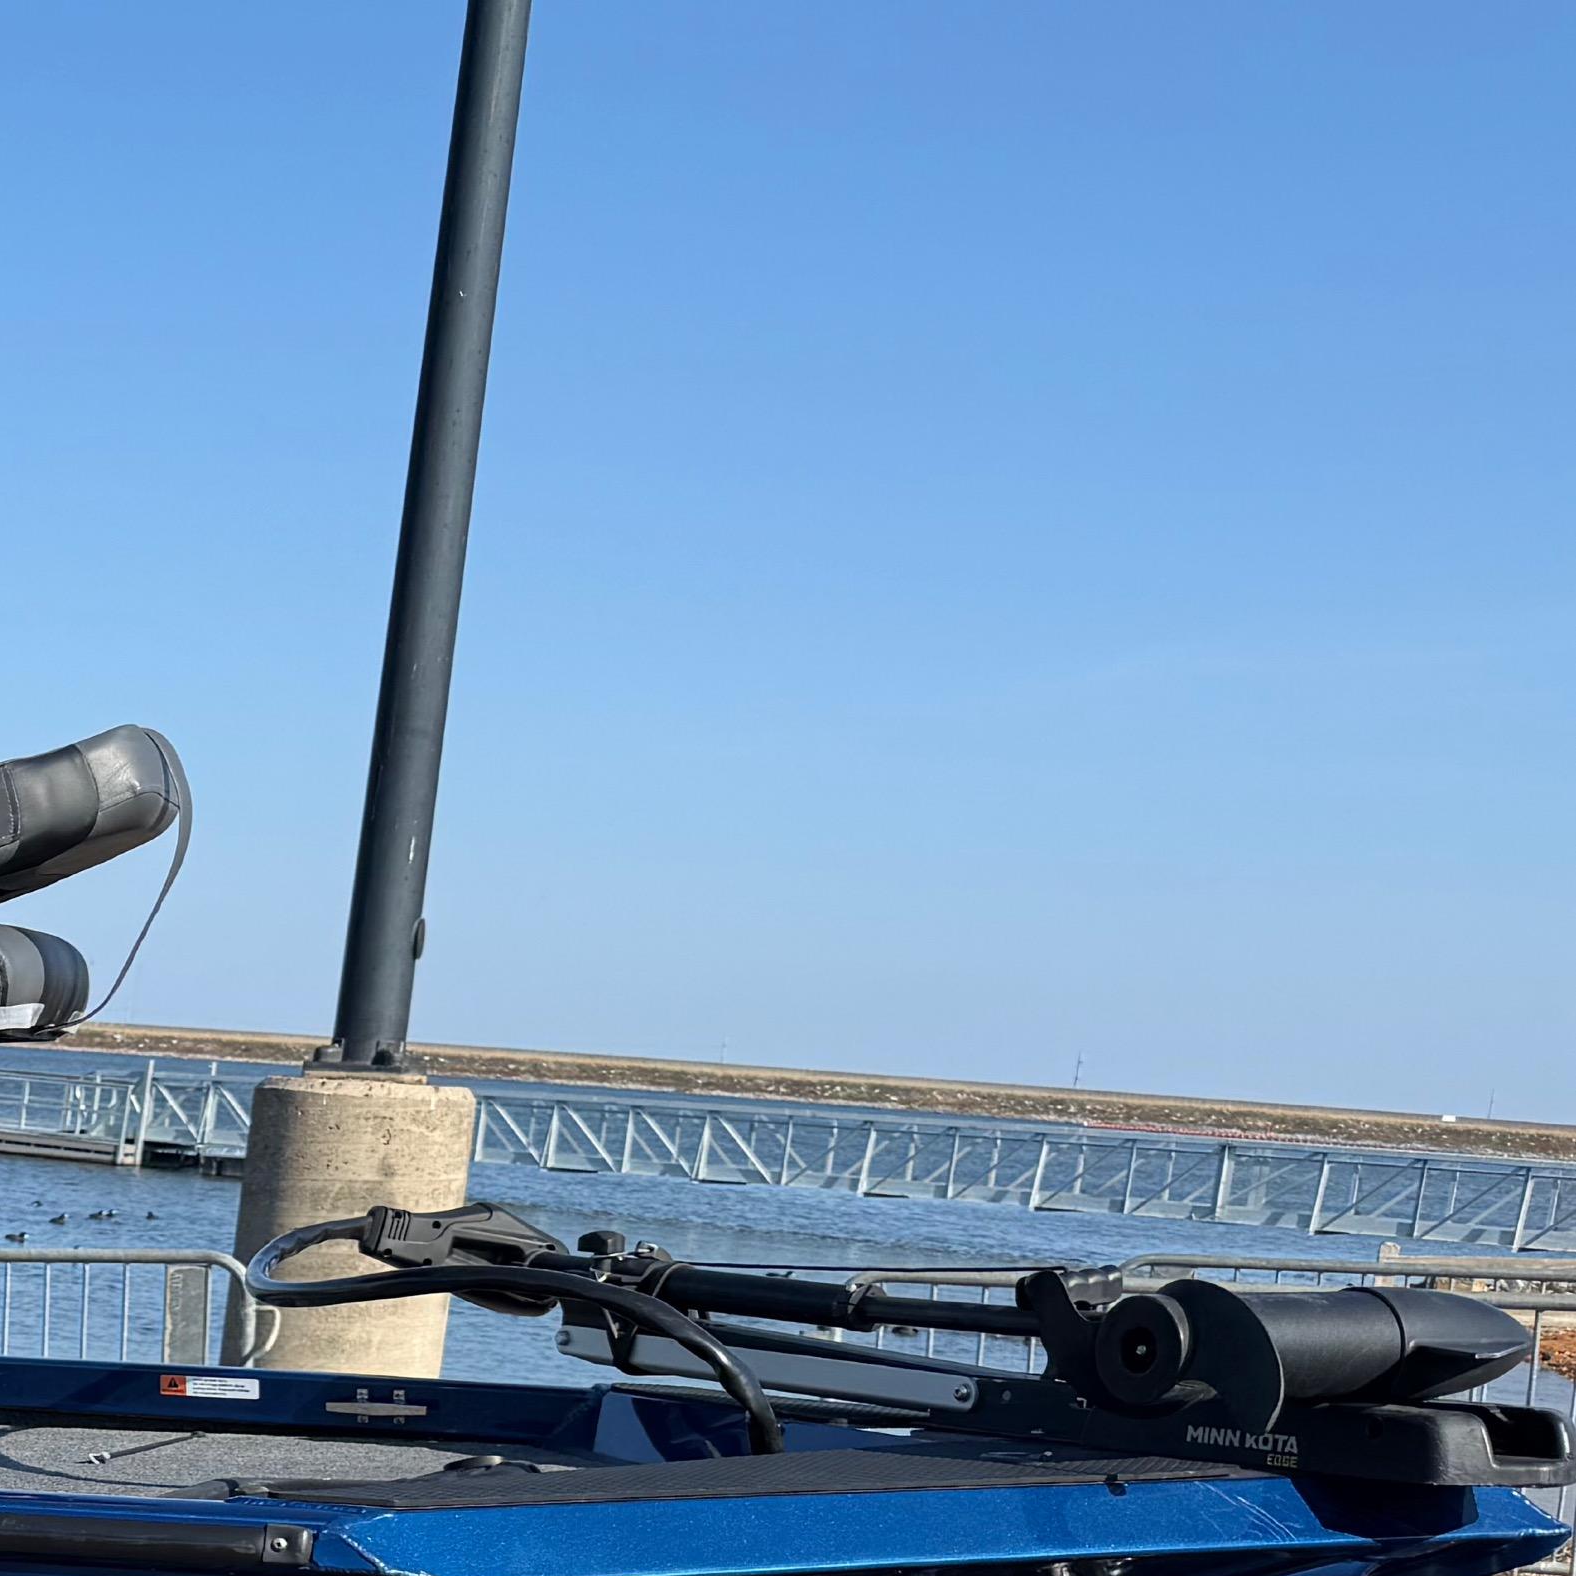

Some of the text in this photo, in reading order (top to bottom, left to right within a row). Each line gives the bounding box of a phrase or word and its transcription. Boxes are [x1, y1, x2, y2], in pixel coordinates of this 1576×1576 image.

[1186, 1425, 1298, 1454] MINN KOTA
[1266, 1453, 1298, 1468] EDGE
